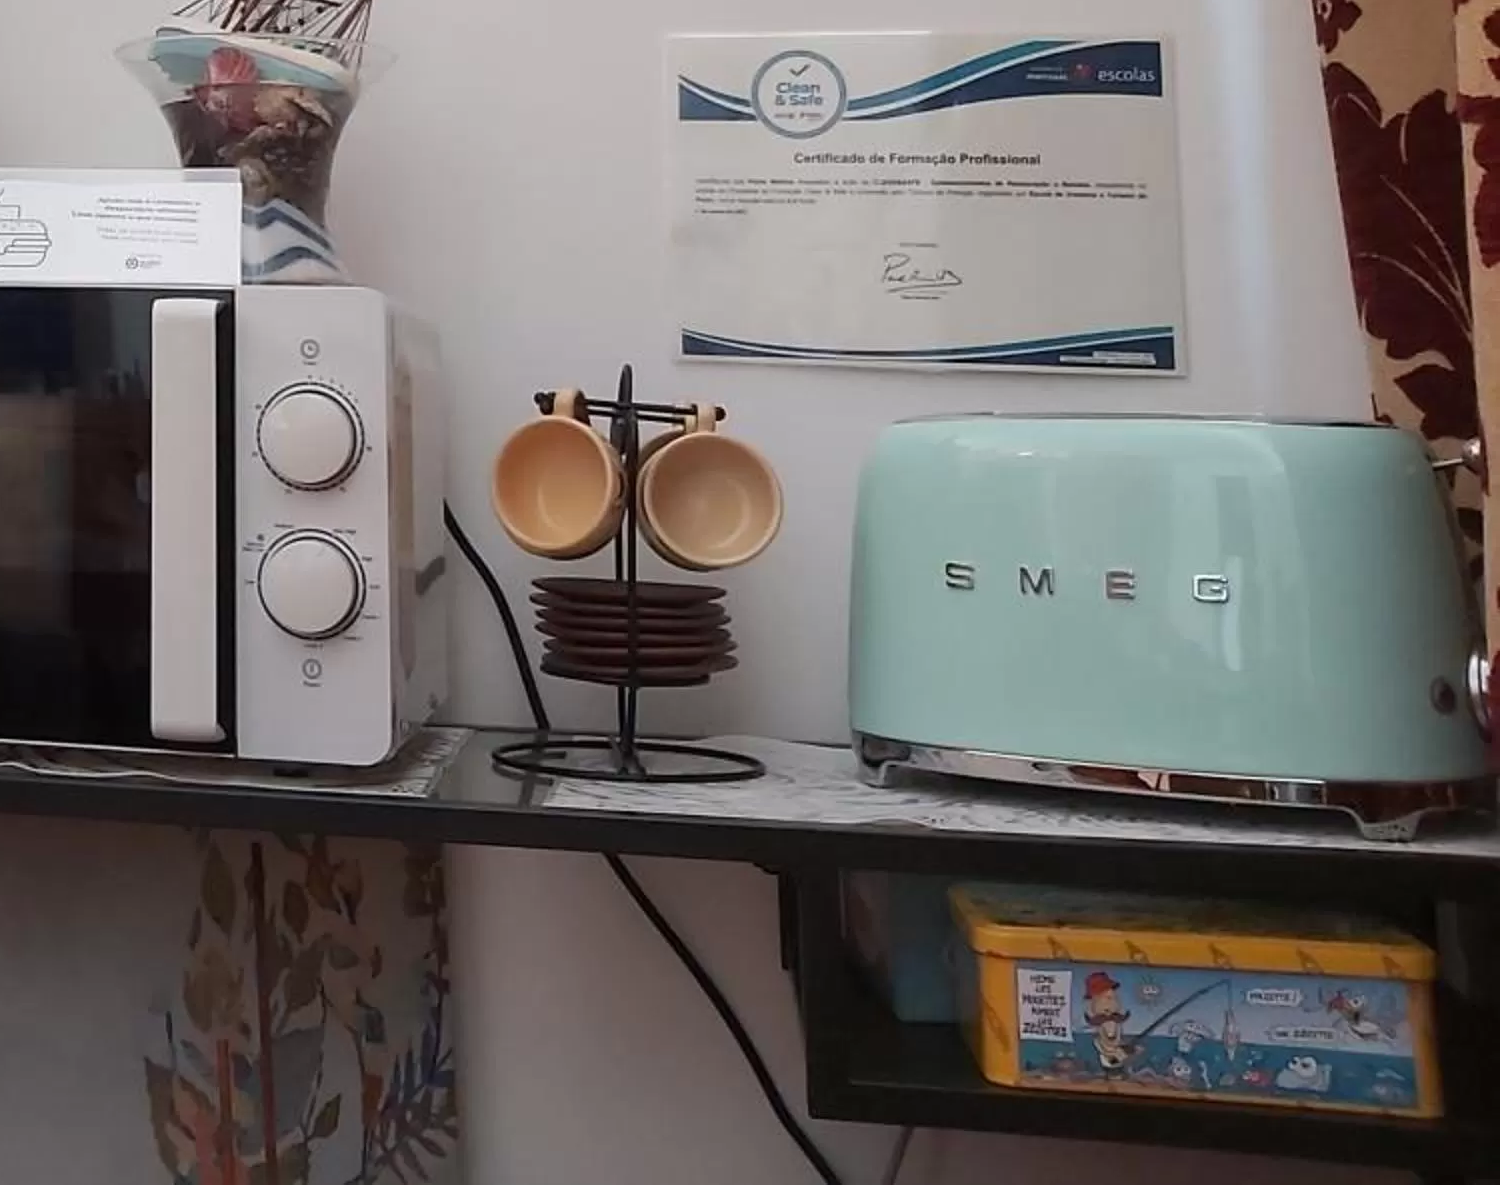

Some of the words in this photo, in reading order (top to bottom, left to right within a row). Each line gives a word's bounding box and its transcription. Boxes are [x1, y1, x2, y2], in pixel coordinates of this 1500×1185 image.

[1097, 66, 1156, 83] escolas
[775, 81, 821, 94] Clean
[788, 94, 824, 106] Safe
[793, 152, 865, 165] Certificado
[869, 152, 885, 165] de
[888, 151, 957, 167] Formação
[959, 152, 1041, 165] Profissional
[944, 561, 1231, 604] SMEG
